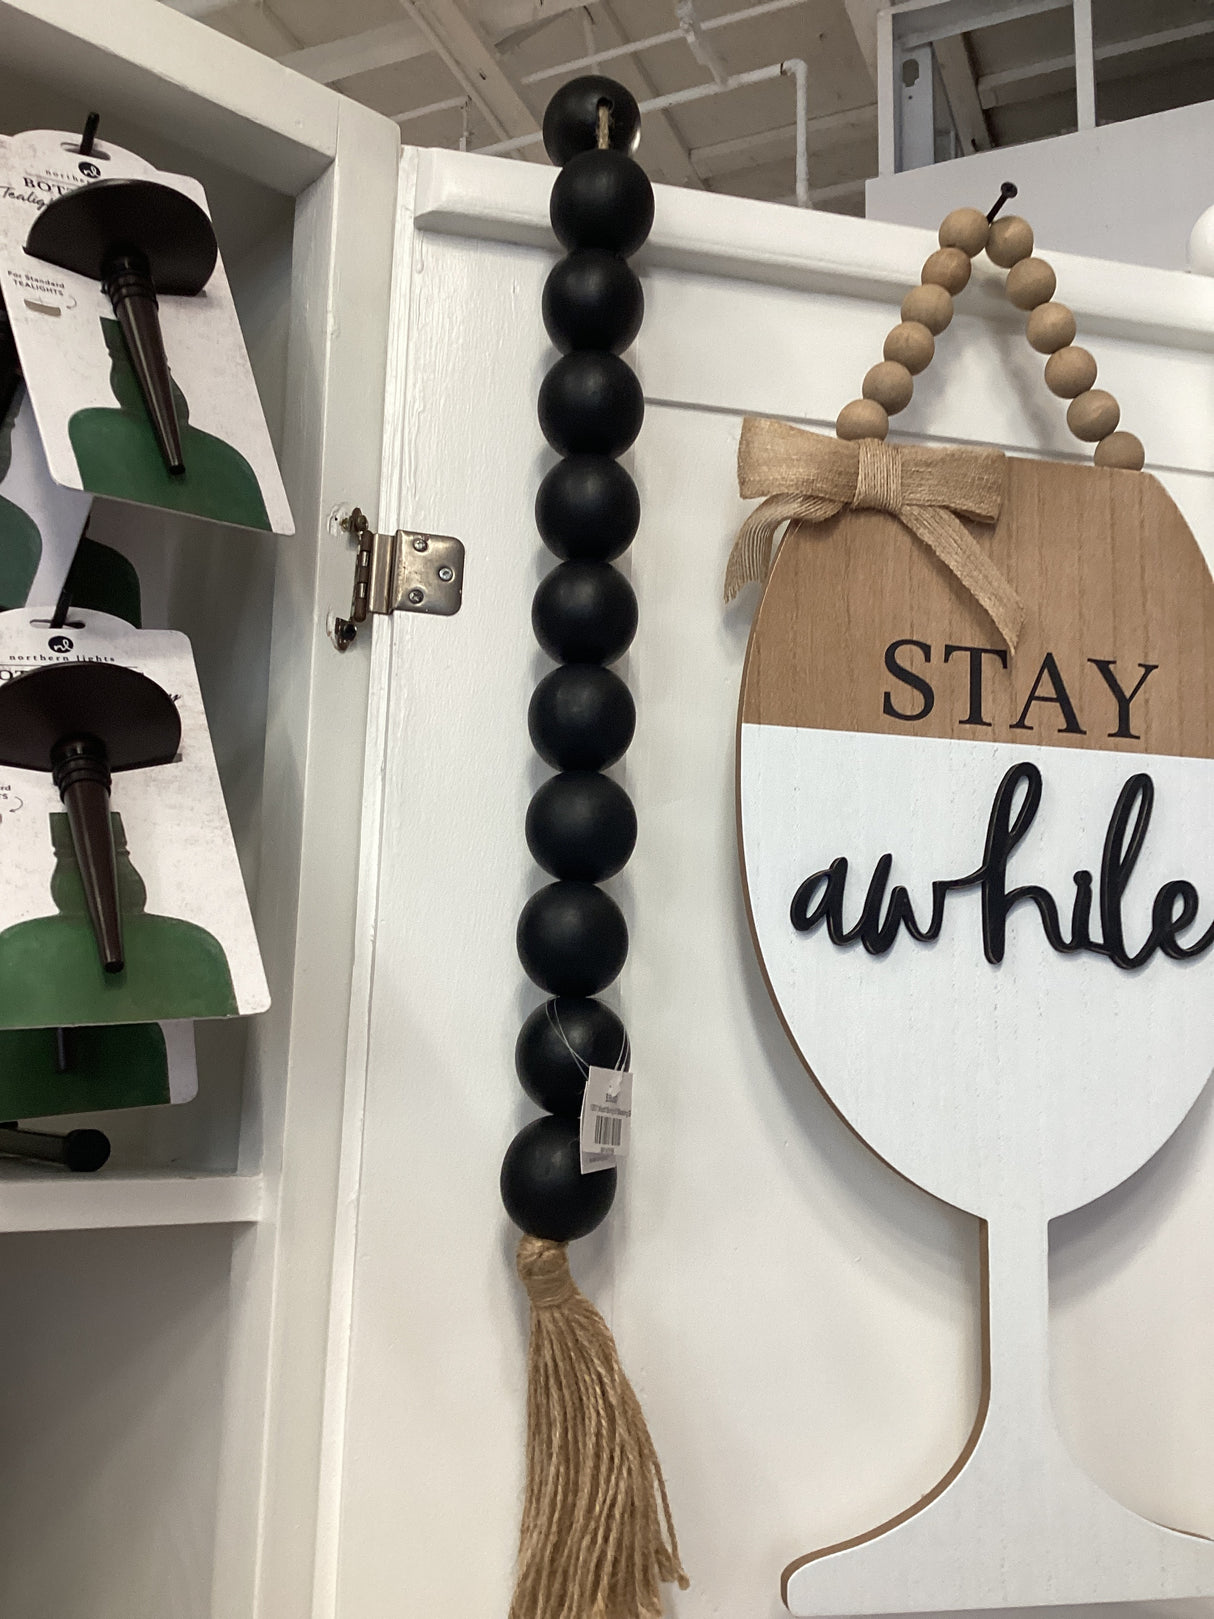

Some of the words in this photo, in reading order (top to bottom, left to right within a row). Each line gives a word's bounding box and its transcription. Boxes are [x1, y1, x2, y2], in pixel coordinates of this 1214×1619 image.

[23, 177, 73, 197] BOT
[45, 169, 91, 185] northe
[0, 186, 54, 210] Tealig
[13, 278, 64, 296] TEALIGHTS
[24, 274, 65, 289] Standard
[882, 638, 1159, 740] STAY
[790, 761, 1214, 970] awhile
